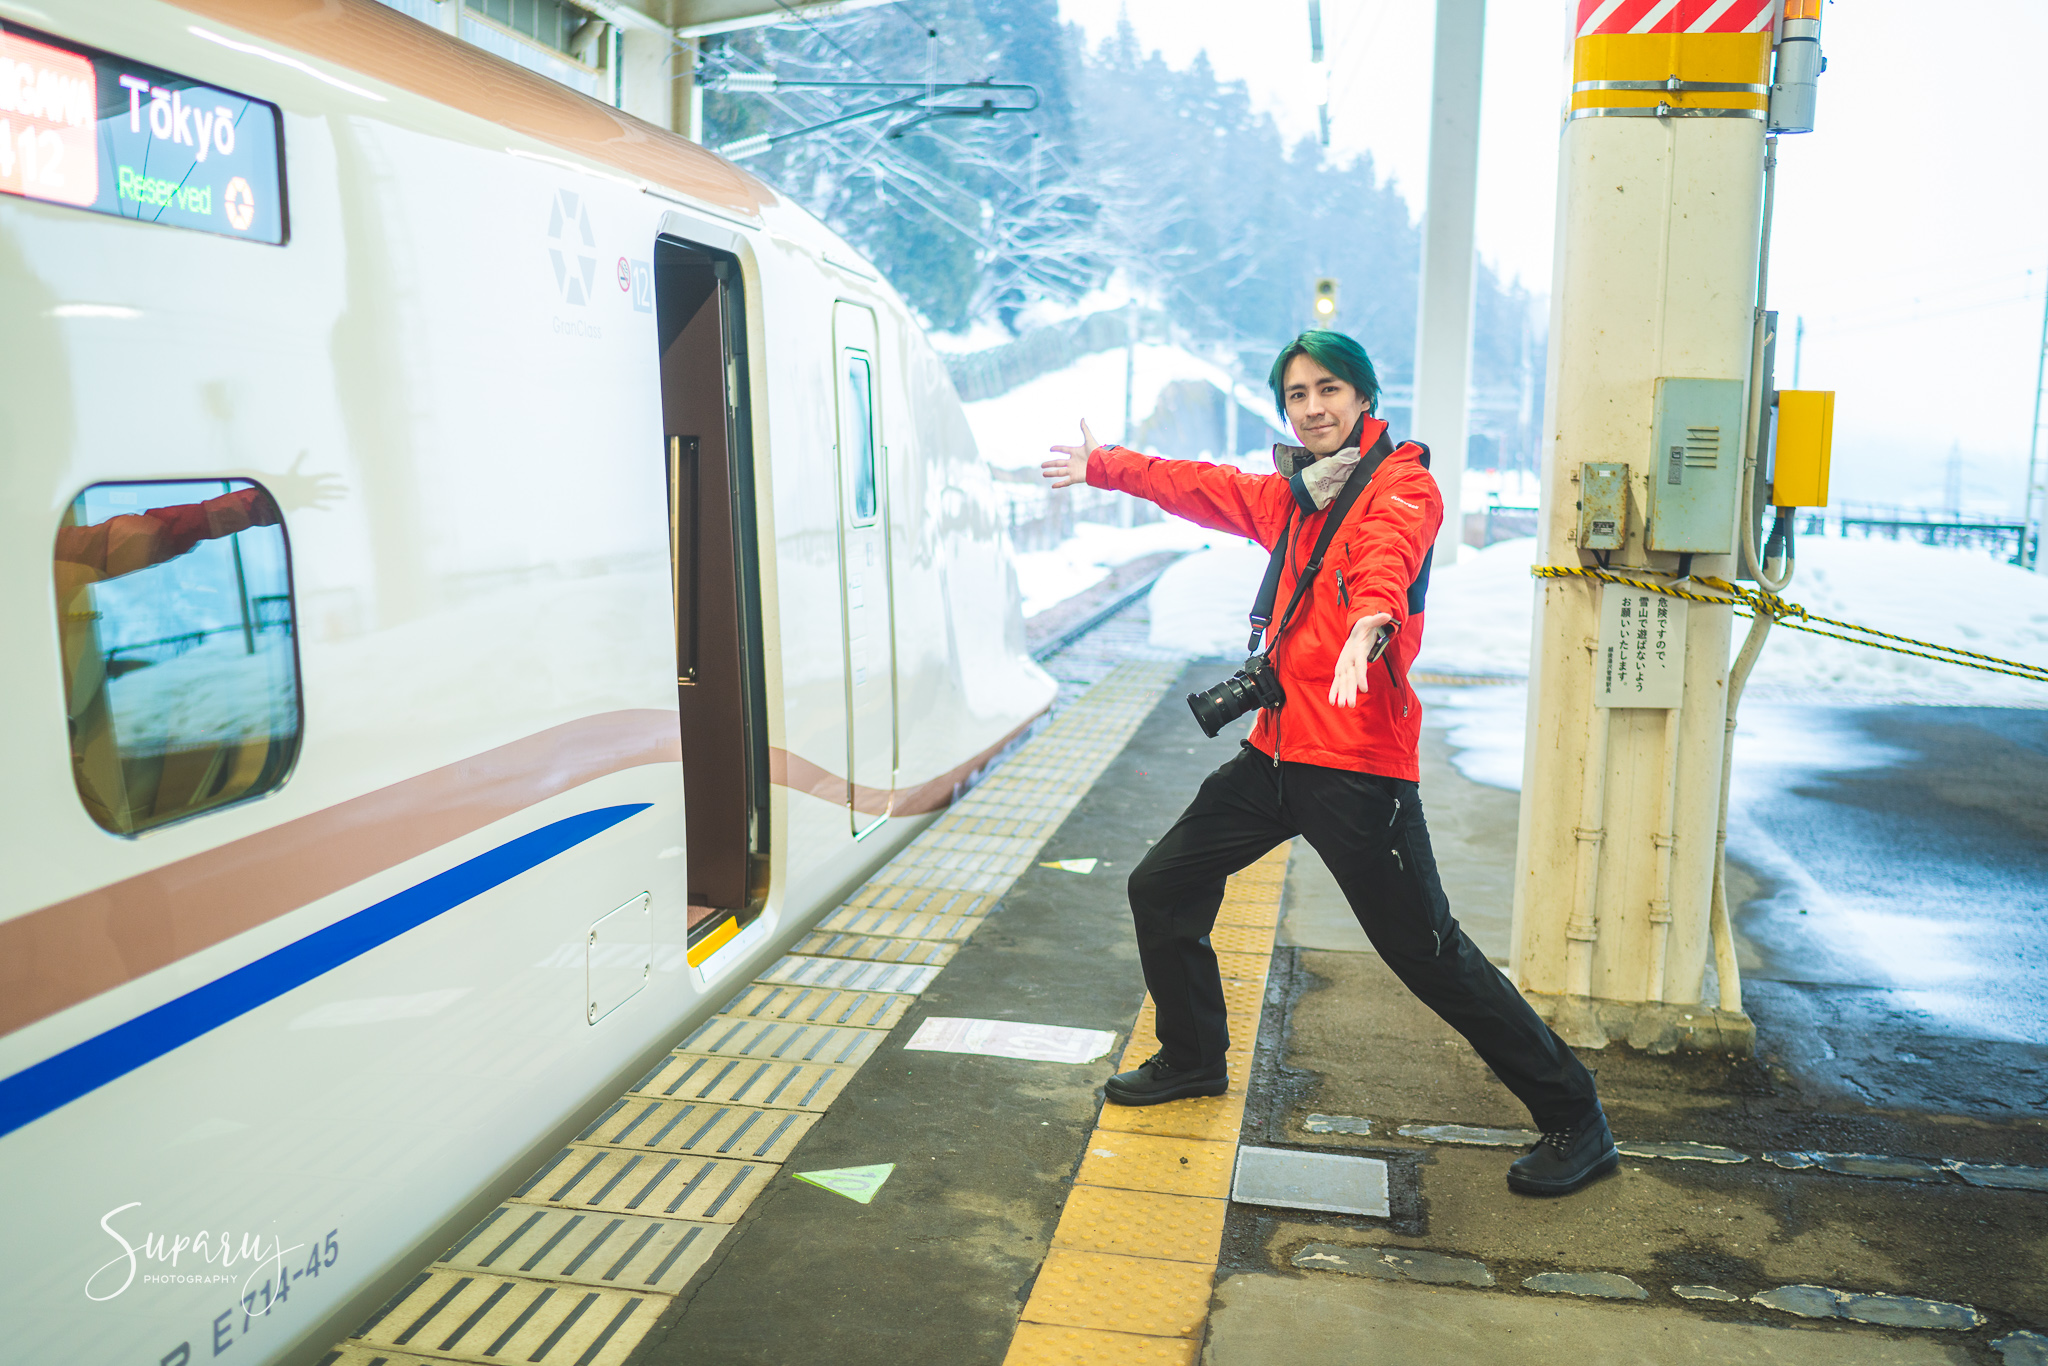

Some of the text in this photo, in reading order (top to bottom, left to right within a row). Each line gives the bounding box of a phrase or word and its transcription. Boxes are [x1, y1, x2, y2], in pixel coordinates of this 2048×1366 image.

[119, 74, 235, 163] Tōkyō
[117, 164, 212, 215] Reserved
[633, 266, 650, 308] 12
[552, 315, 602, 339] GranClass
[1618, 597, 1631, 686] お願いいたします。
[1636, 596, 1649, 692] 雪山で遊ばないよう
[1656, 597, 1668, 669] 危険ですので、
